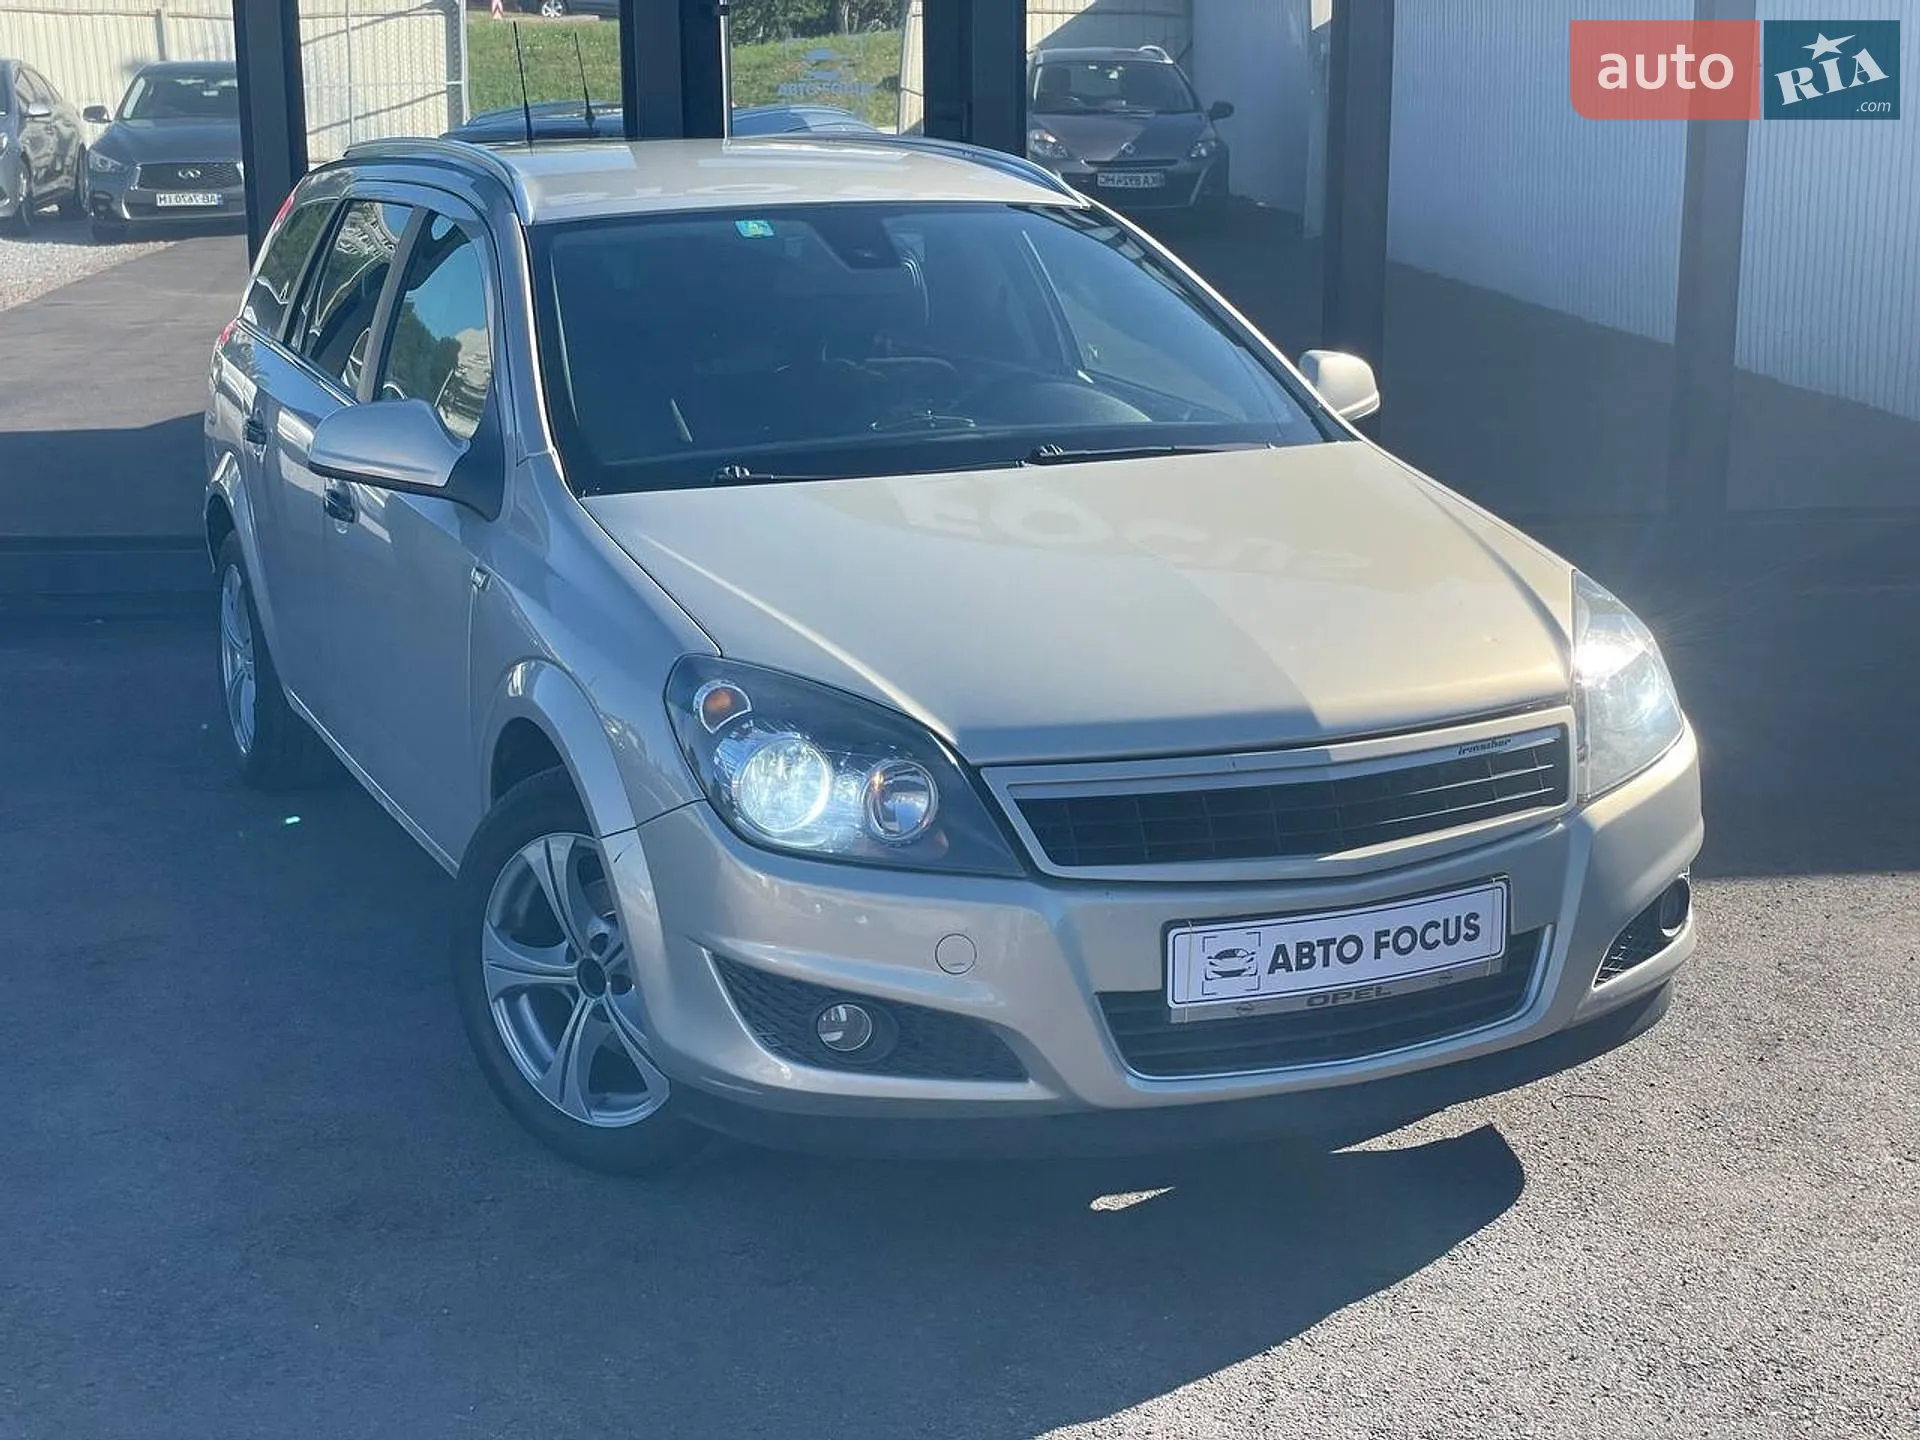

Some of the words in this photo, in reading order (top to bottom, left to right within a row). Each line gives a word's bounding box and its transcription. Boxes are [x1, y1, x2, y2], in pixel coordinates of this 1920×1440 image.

[1267, 934, 1365, 976] АВТО
[1372, 911, 1482, 962] FOCUS
[1306, 986, 1393, 1008] OPEL
